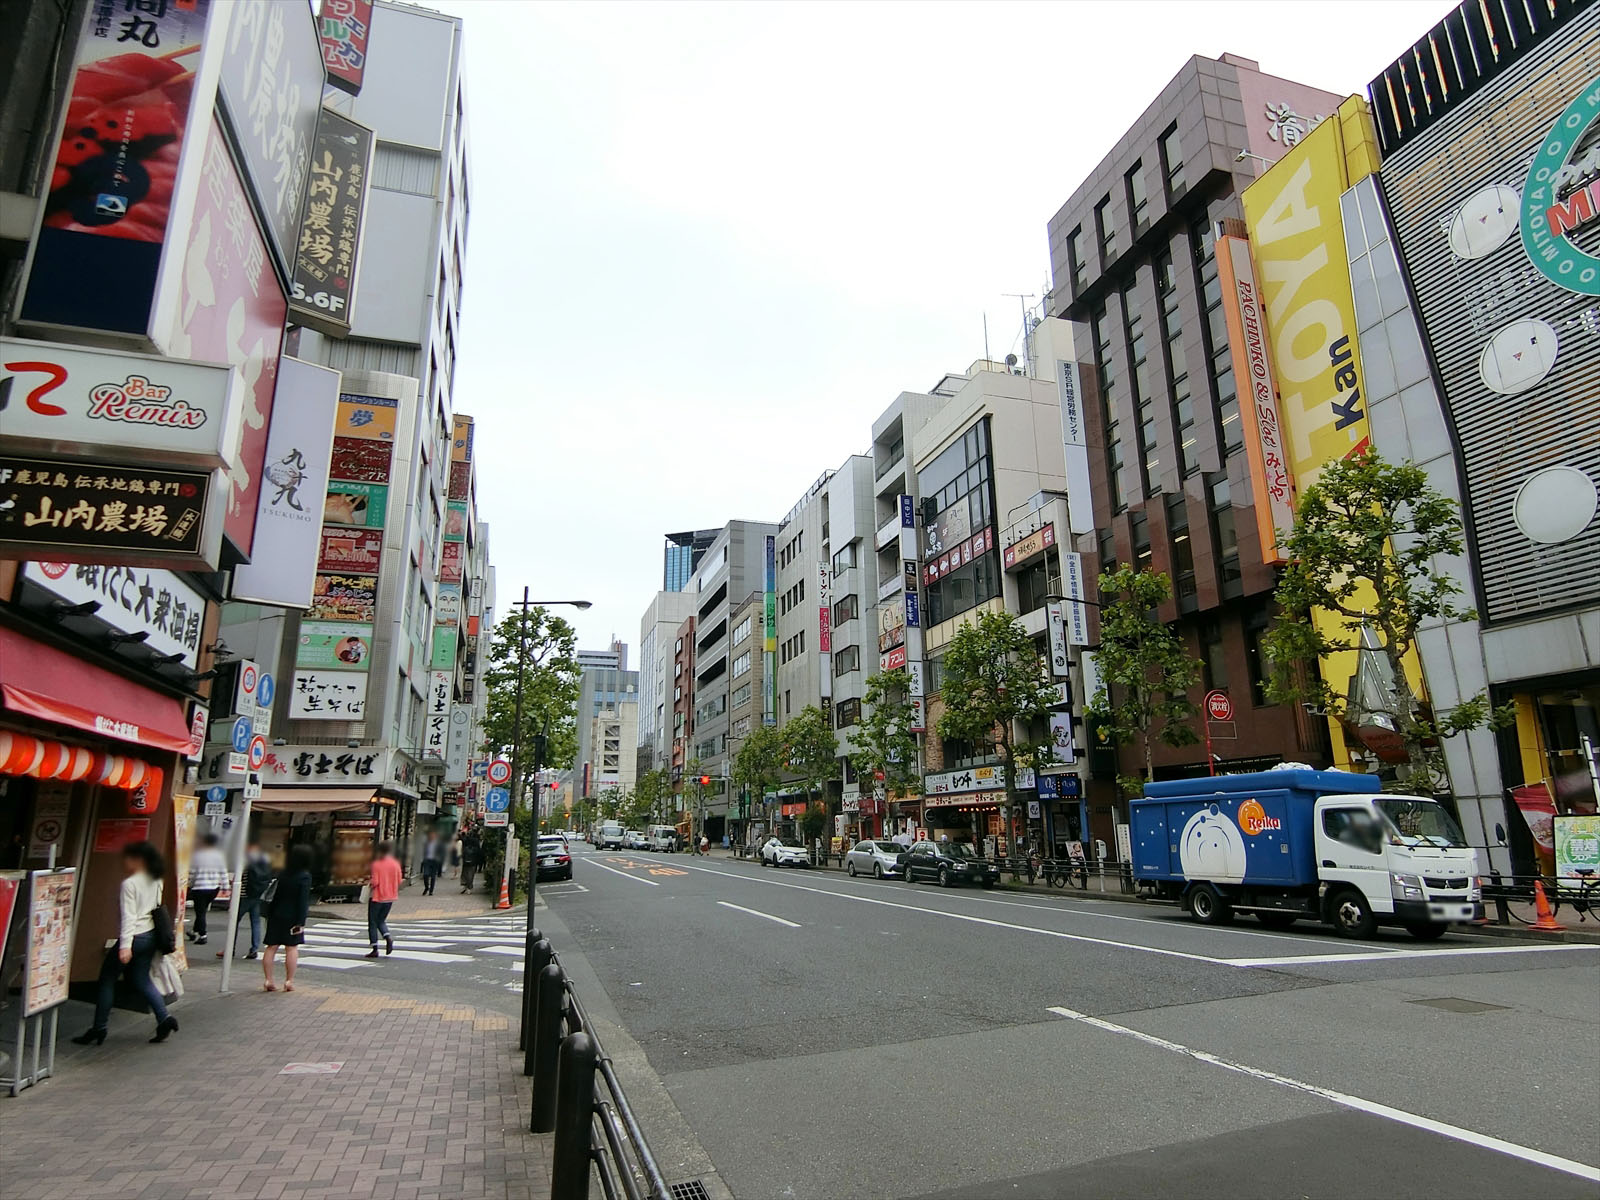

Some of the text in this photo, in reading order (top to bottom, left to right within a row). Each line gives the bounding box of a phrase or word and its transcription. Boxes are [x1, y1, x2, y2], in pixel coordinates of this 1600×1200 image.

[346, 163, 362, 199] 鹿児島
[301, 151, 344, 264] 山内農場
[1546, 177, 1600, 238] M
[1237, 279, 1277, 449] PACHINKO & Slot
[1328, 335, 1365, 432] Kan
[93, 386, 201, 426] Remix
[125, 378, 168, 398] Bar
[13, 469, 69, 488] 鹿児島
[270, 448, 308, 512] 九十九
[1264, 451, 1286, 503] みとや
[24, 496, 169, 537] 山内農場
[303, 695, 365, 713] 生そば
[429, 683, 446, 746] 富士そば
[293, 751, 379, 777] 富士そば
[493, 766, 506, 777] 40
[491, 793, 500, 809] P
[1248, 815, 1281, 831] Reika
